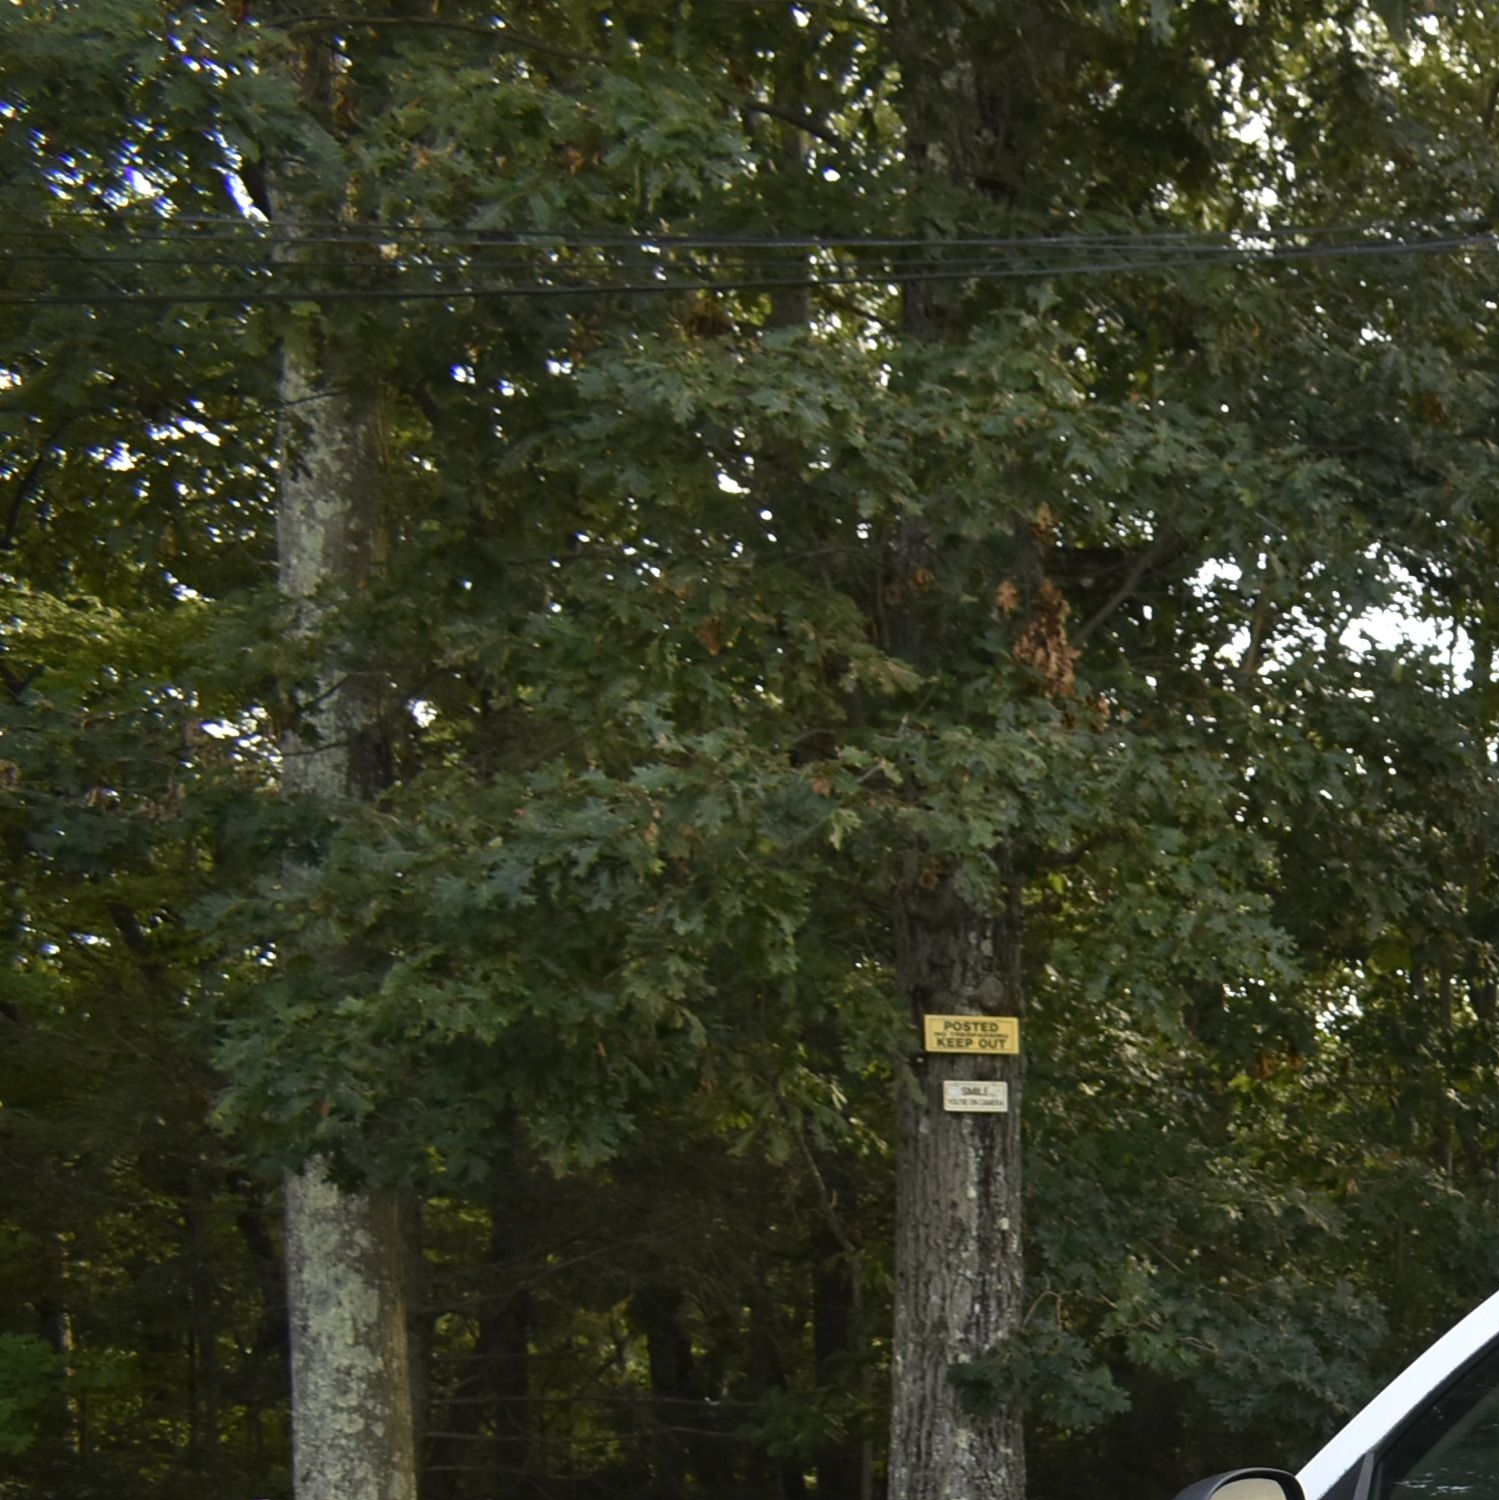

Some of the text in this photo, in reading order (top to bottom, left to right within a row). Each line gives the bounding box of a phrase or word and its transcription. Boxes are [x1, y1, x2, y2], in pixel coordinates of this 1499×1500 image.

[944, 1021, 999, 1032] POSTED
[937, 1038, 1006, 1049] KEEP OUT
